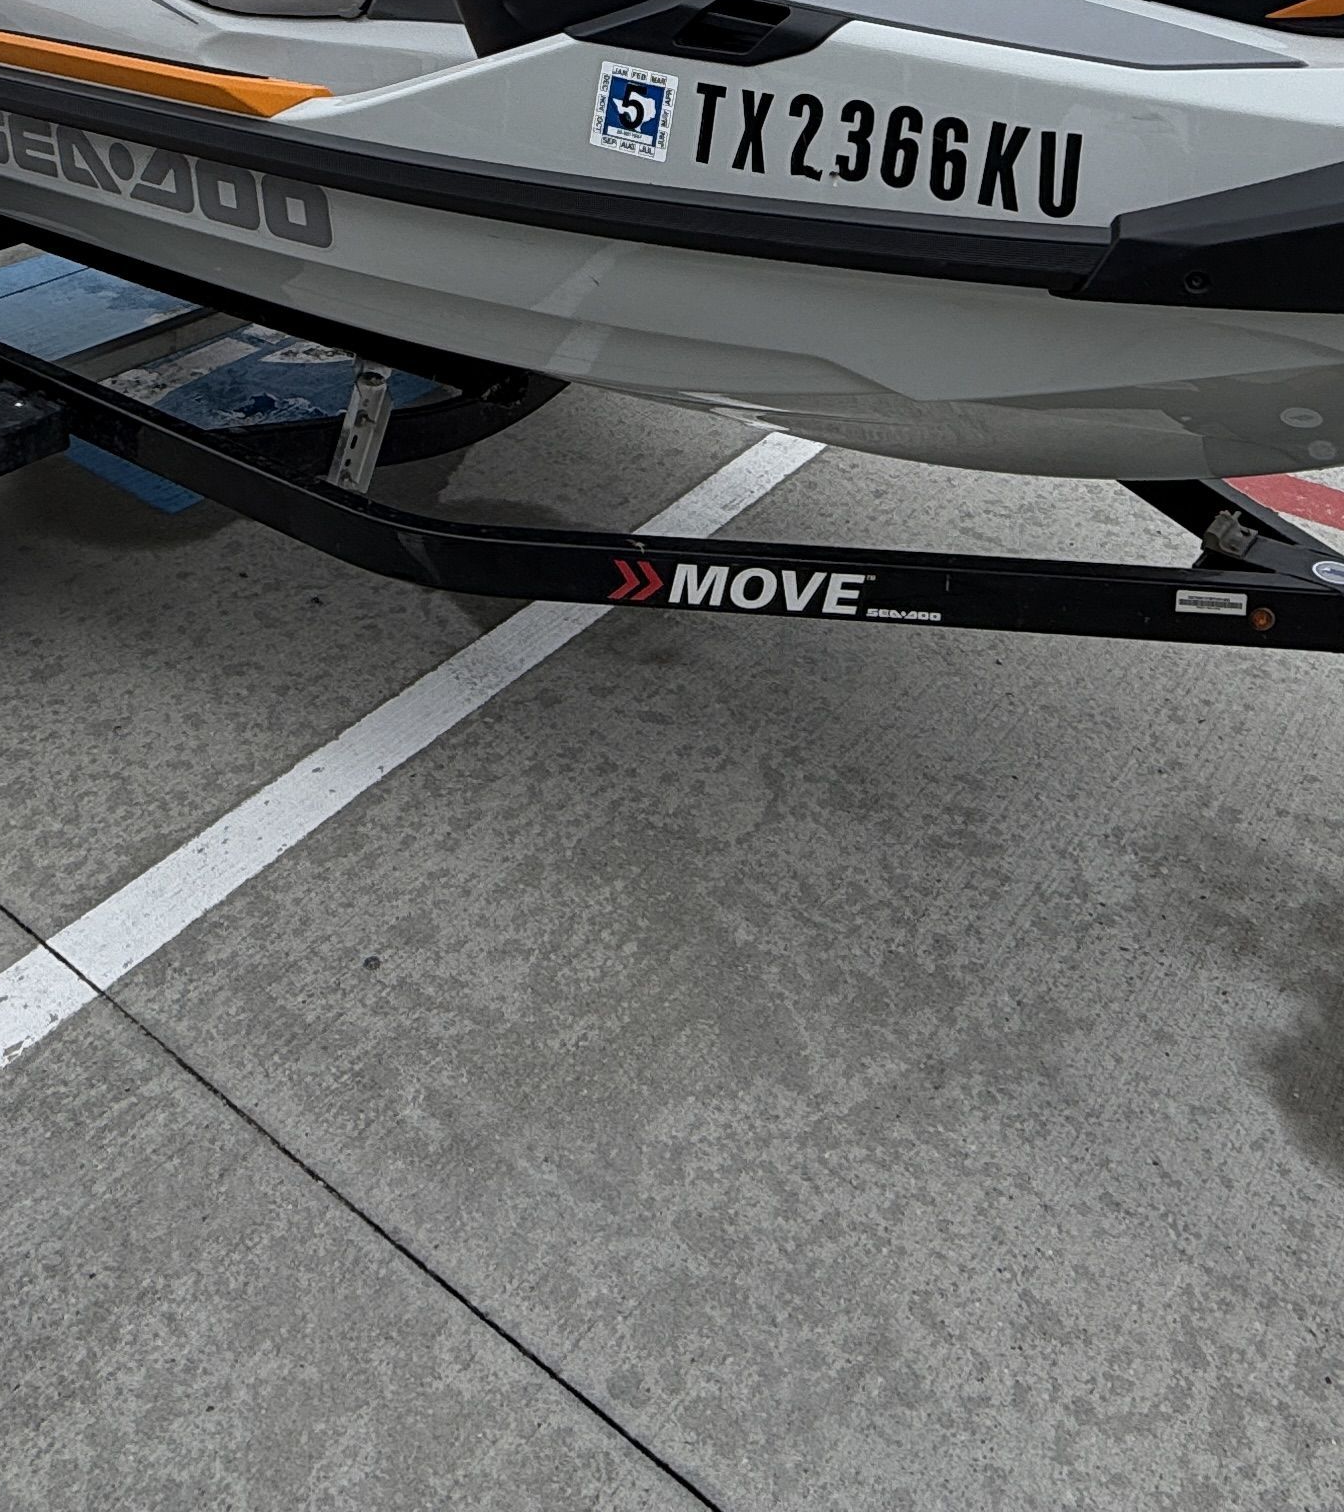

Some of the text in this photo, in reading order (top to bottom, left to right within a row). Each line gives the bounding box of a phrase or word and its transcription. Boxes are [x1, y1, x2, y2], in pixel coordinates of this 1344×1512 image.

[618, 83, 648, 130] 5
[620, 141, 636, 150] AUG
[639, 146, 654, 155] JUL
[668, 563, 866, 615] MOVE
